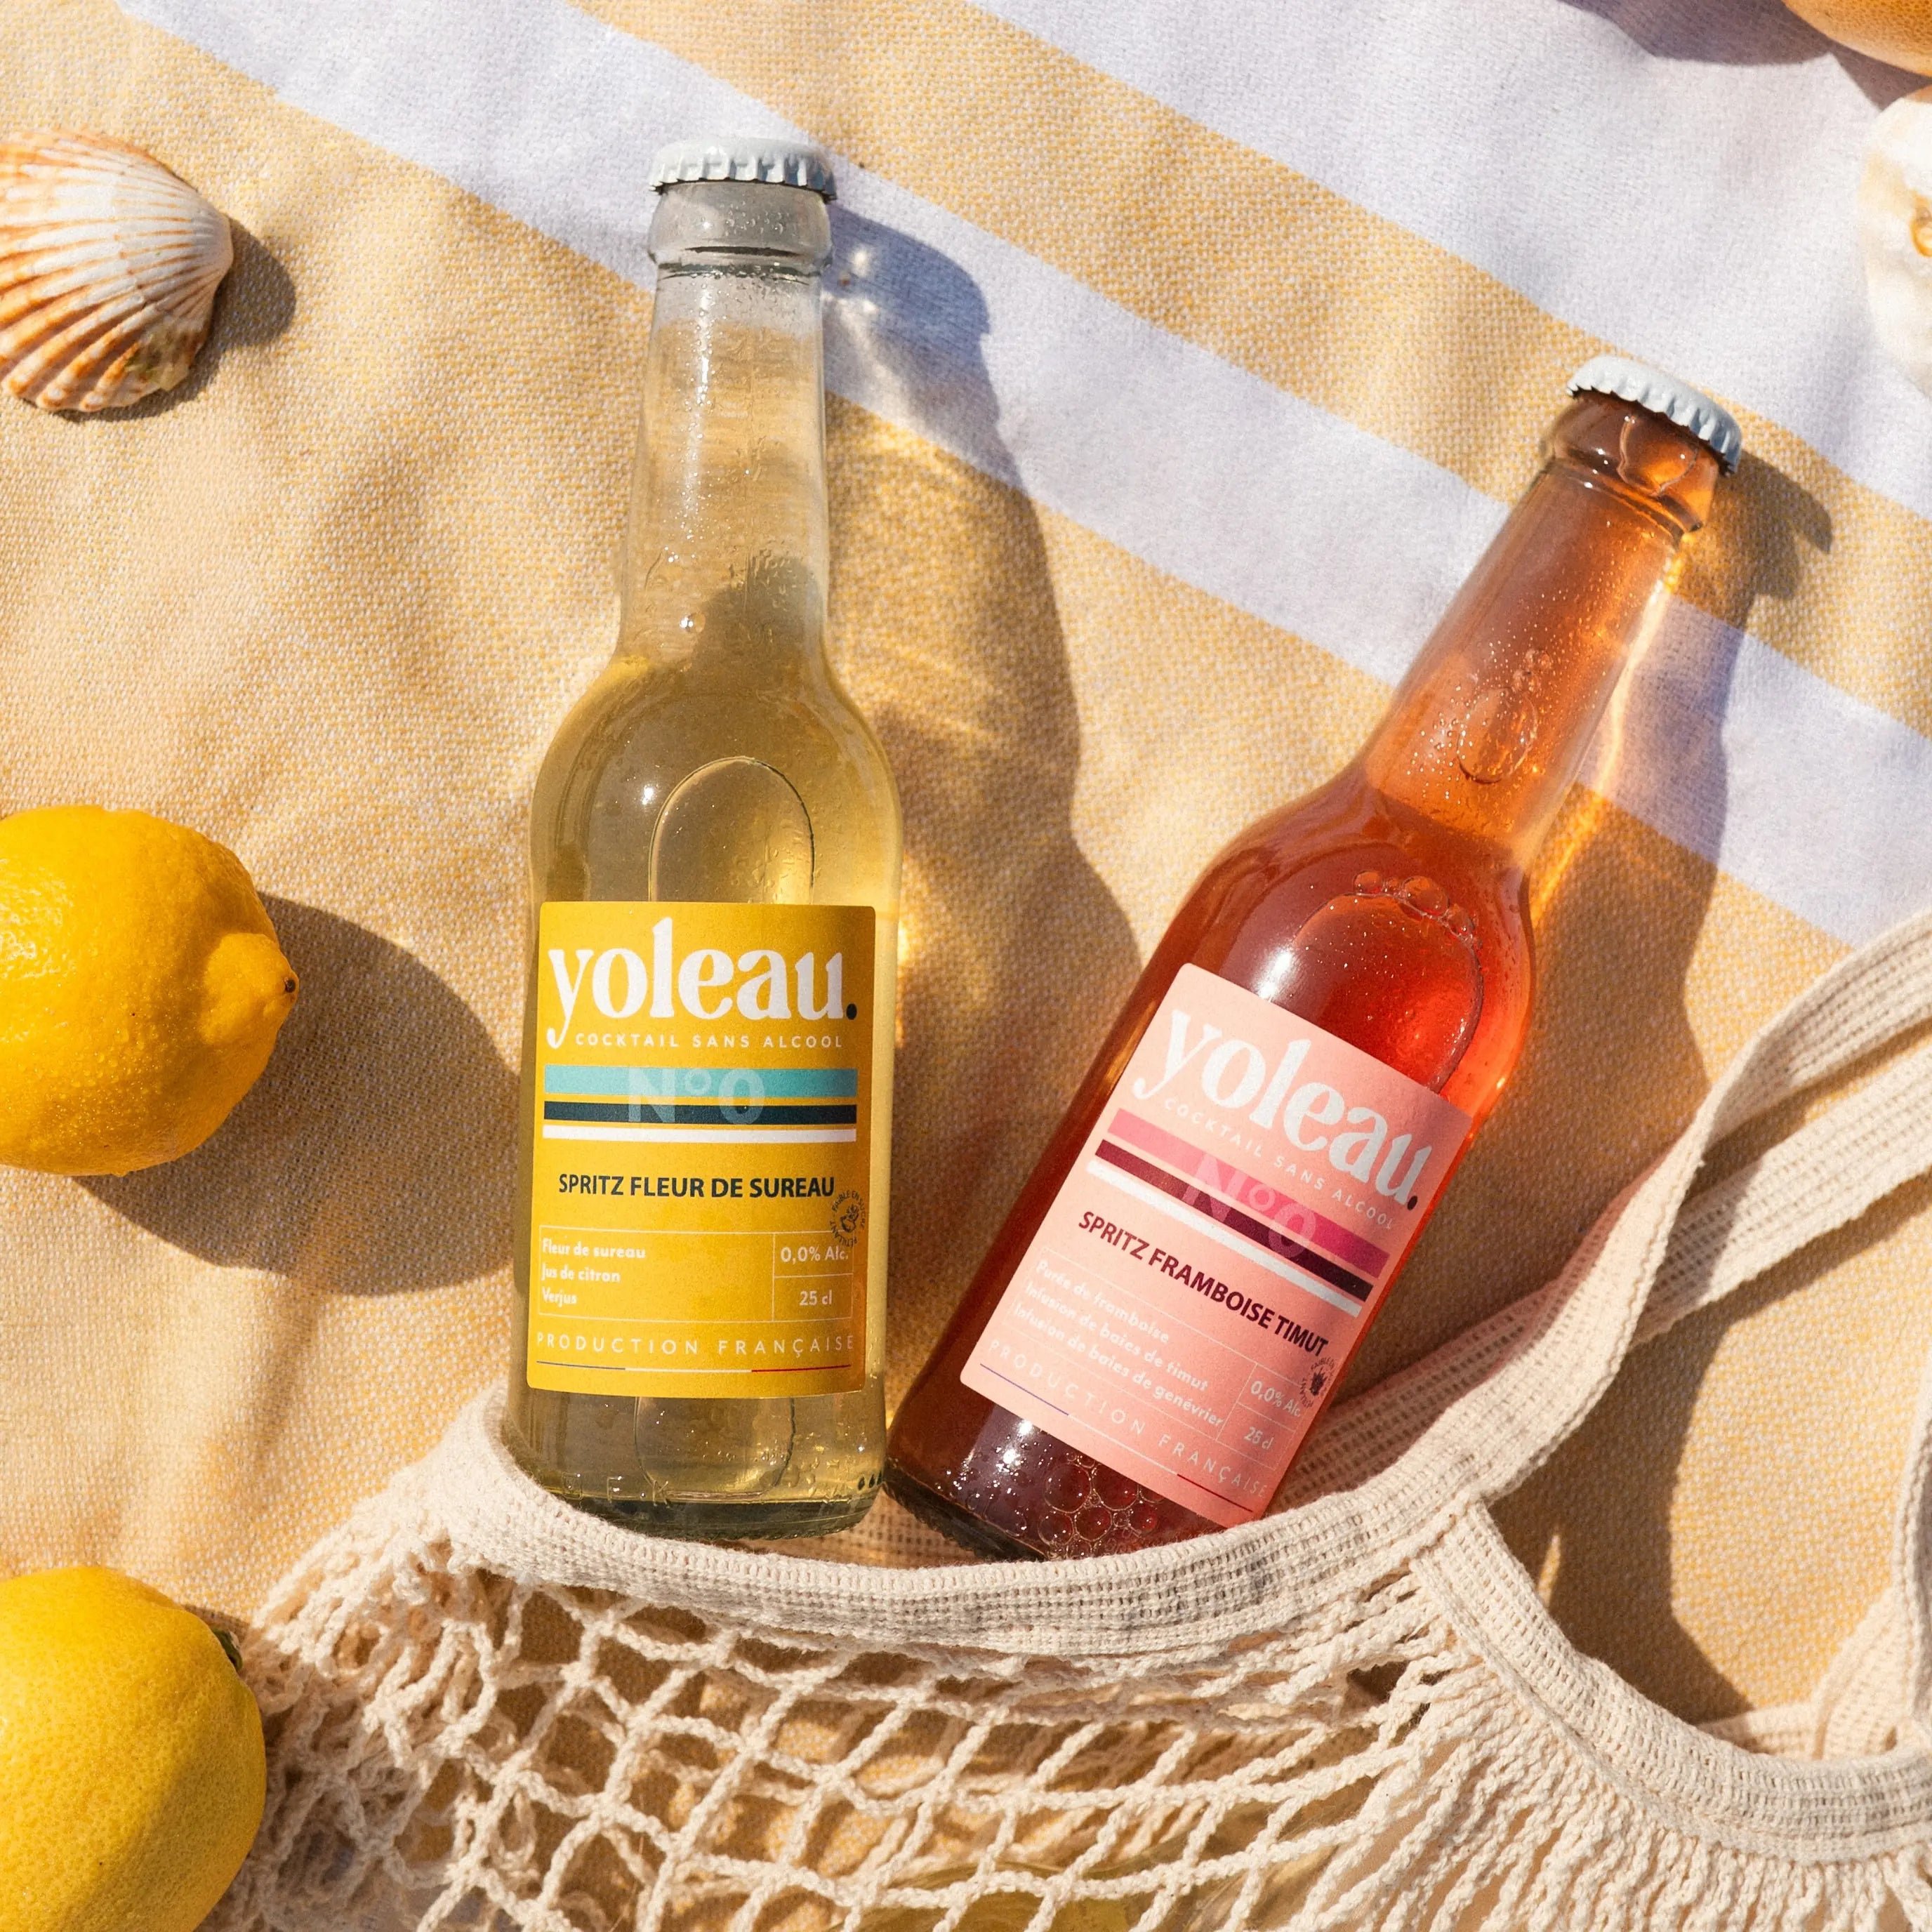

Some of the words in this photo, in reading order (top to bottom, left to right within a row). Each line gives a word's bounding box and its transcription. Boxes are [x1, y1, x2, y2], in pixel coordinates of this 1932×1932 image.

[576, 1033, 678, 1047] COCKTAIL
[692, 1034, 749, 1048] SANS
[763, 1034, 842, 1049] ALCOOL
[1164, 1099, 1262, 1158] COCKTAIL
[1273, 1156, 1325, 1191] SANS
[1331, 1189, 1393, 1229] ALCOOL
[559, 1173, 624, 1196] SPRITZ
[631, 1176, 705, 1198] FLEUR
[711, 1177, 743, 1198] DE
[750, 1177, 835, 1198] SUREAU
[542, 1238, 570, 1255] Fleur
[574, 1241, 590, 1257] de
[593, 1246, 647, 1259] sureau
[780, 1245, 821, 1265] 0,0%
[541, 1262, 557, 1281] Jus
[560, 1264, 575, 1281] de
[578, 1266, 621, 1283] citron
[1078, 1212, 1150, 1260] SPRITZ
[1148, 1249, 1275, 1330] FRAMBOISE
[1275, 1315, 1330, 1356] TIMUT
[541, 1286, 578, 1307] Verjus
[800, 1290, 818, 1306] 25
[821, 1290, 833, 1306] cl
[1073, 1282, 1090, 1298] de
[1093, 1292, 1170, 1344] framboise
[537, 1332, 699, 1355] PRODUCTION
[718, 1335, 854, 1357] FRANÇAISE
[1024, 1281, 1078, 1320] Infusion
[1079, 1314, 1097, 1332] de
[1099, 1323, 1142, 1356] baies
[1144, 1350, 1164, 1368] de
[1167, 1362, 1209, 1392] timut
[1013, 1303, 1066, 1342] Infusion
[1067, 1335, 1086, 1353] de
[1088, 1344, 1130, 1377] baies
[1132, 1372, 1153, 1389] de
[1153, 1386, 1224, 1428] genévrier
[1250, 1381, 1285, 1408] 0,0%
[988, 1339, 1146, 1435] PRODUCTION
[1158, 1434, 1268, 1498] FRANÇAISE
